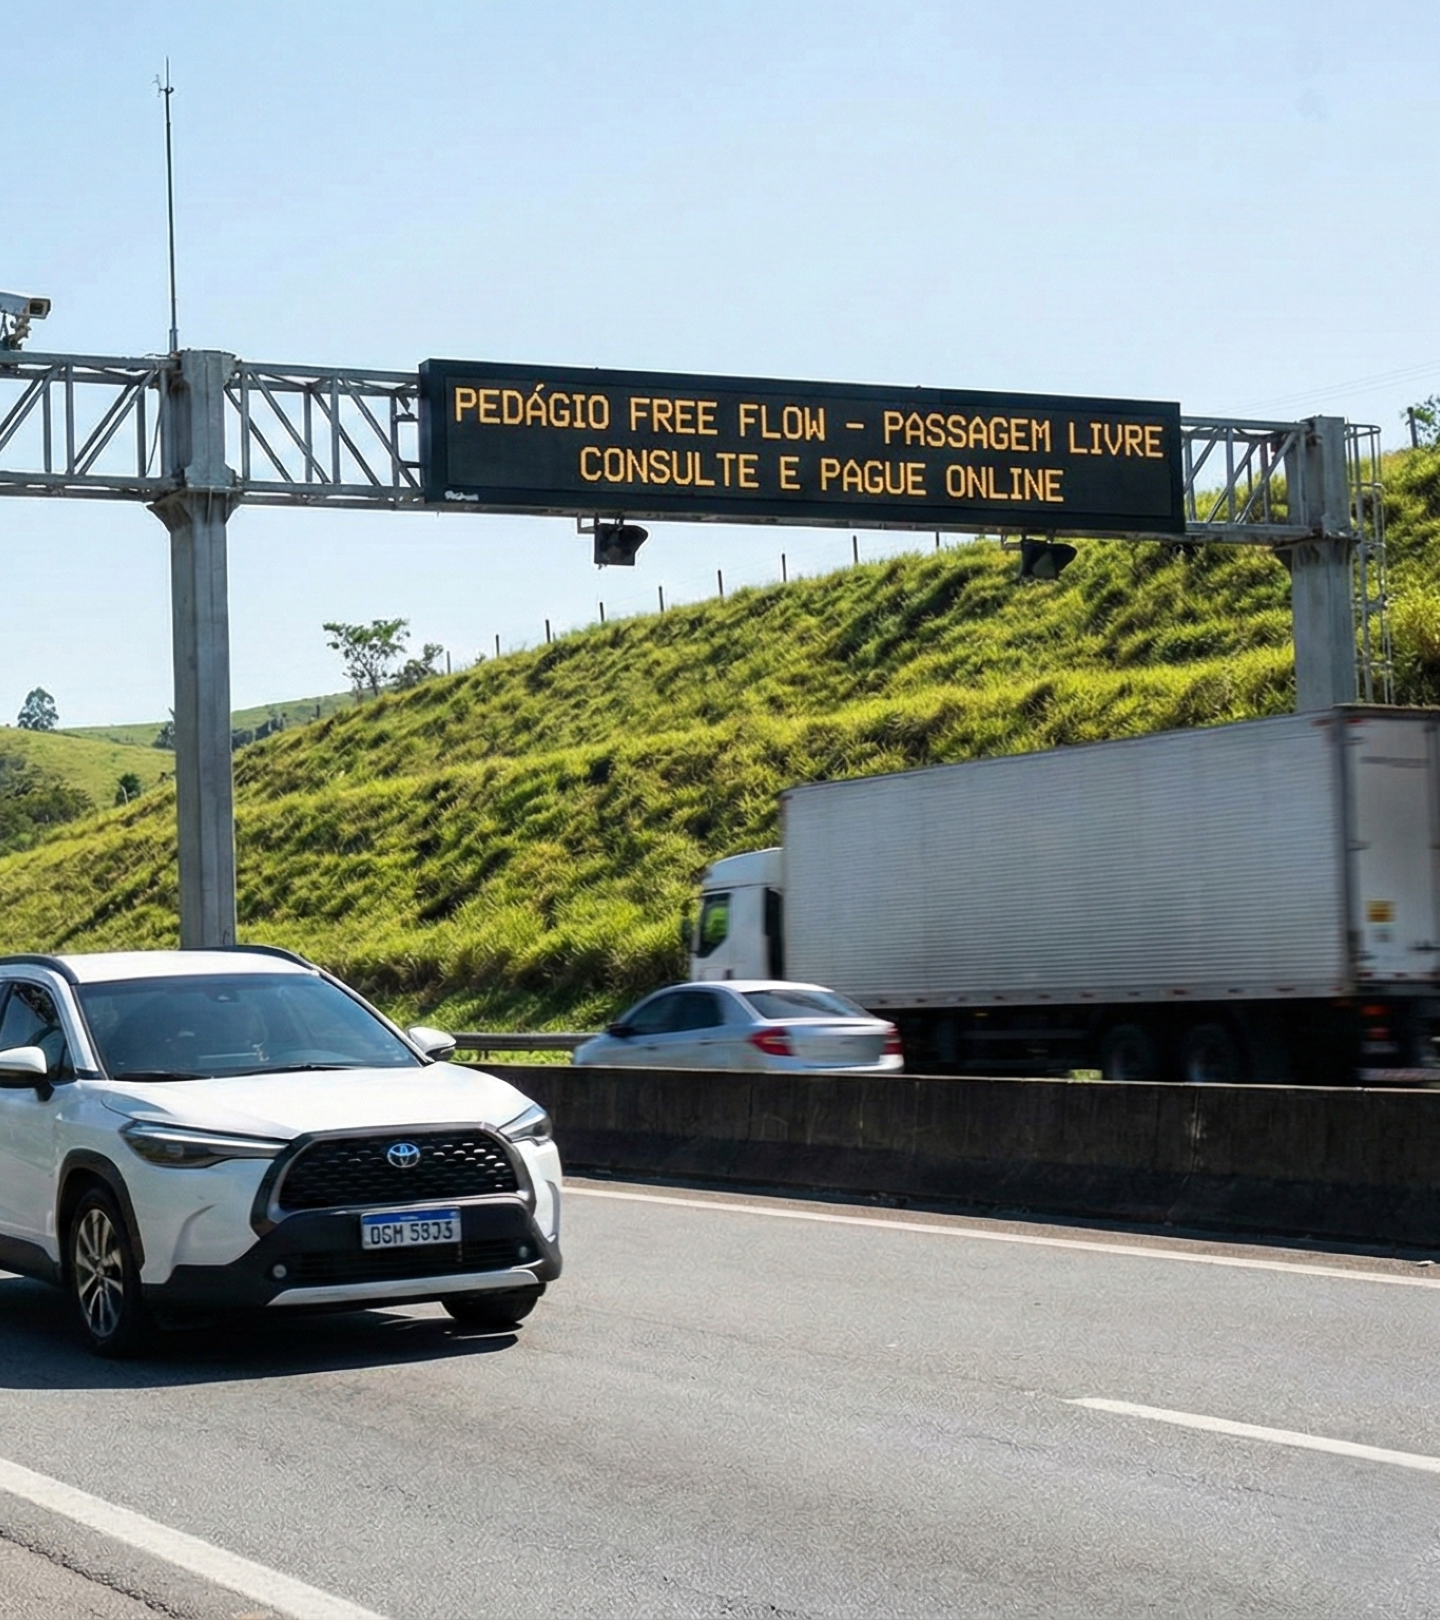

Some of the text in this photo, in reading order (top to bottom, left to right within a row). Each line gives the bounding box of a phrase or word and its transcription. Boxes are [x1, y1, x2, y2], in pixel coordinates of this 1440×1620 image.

[454, 382, 610, 430] PEDÁGIO
[629, 396, 718, 435] FREE
[739, 402, 826, 441] FLOW
[884, 410, 1052, 453] PASSAGEM
[1068, 421, 1164, 459] LIVRE
[579, 446, 1065, 503] CONSULTE E PAGUE ONLINE
